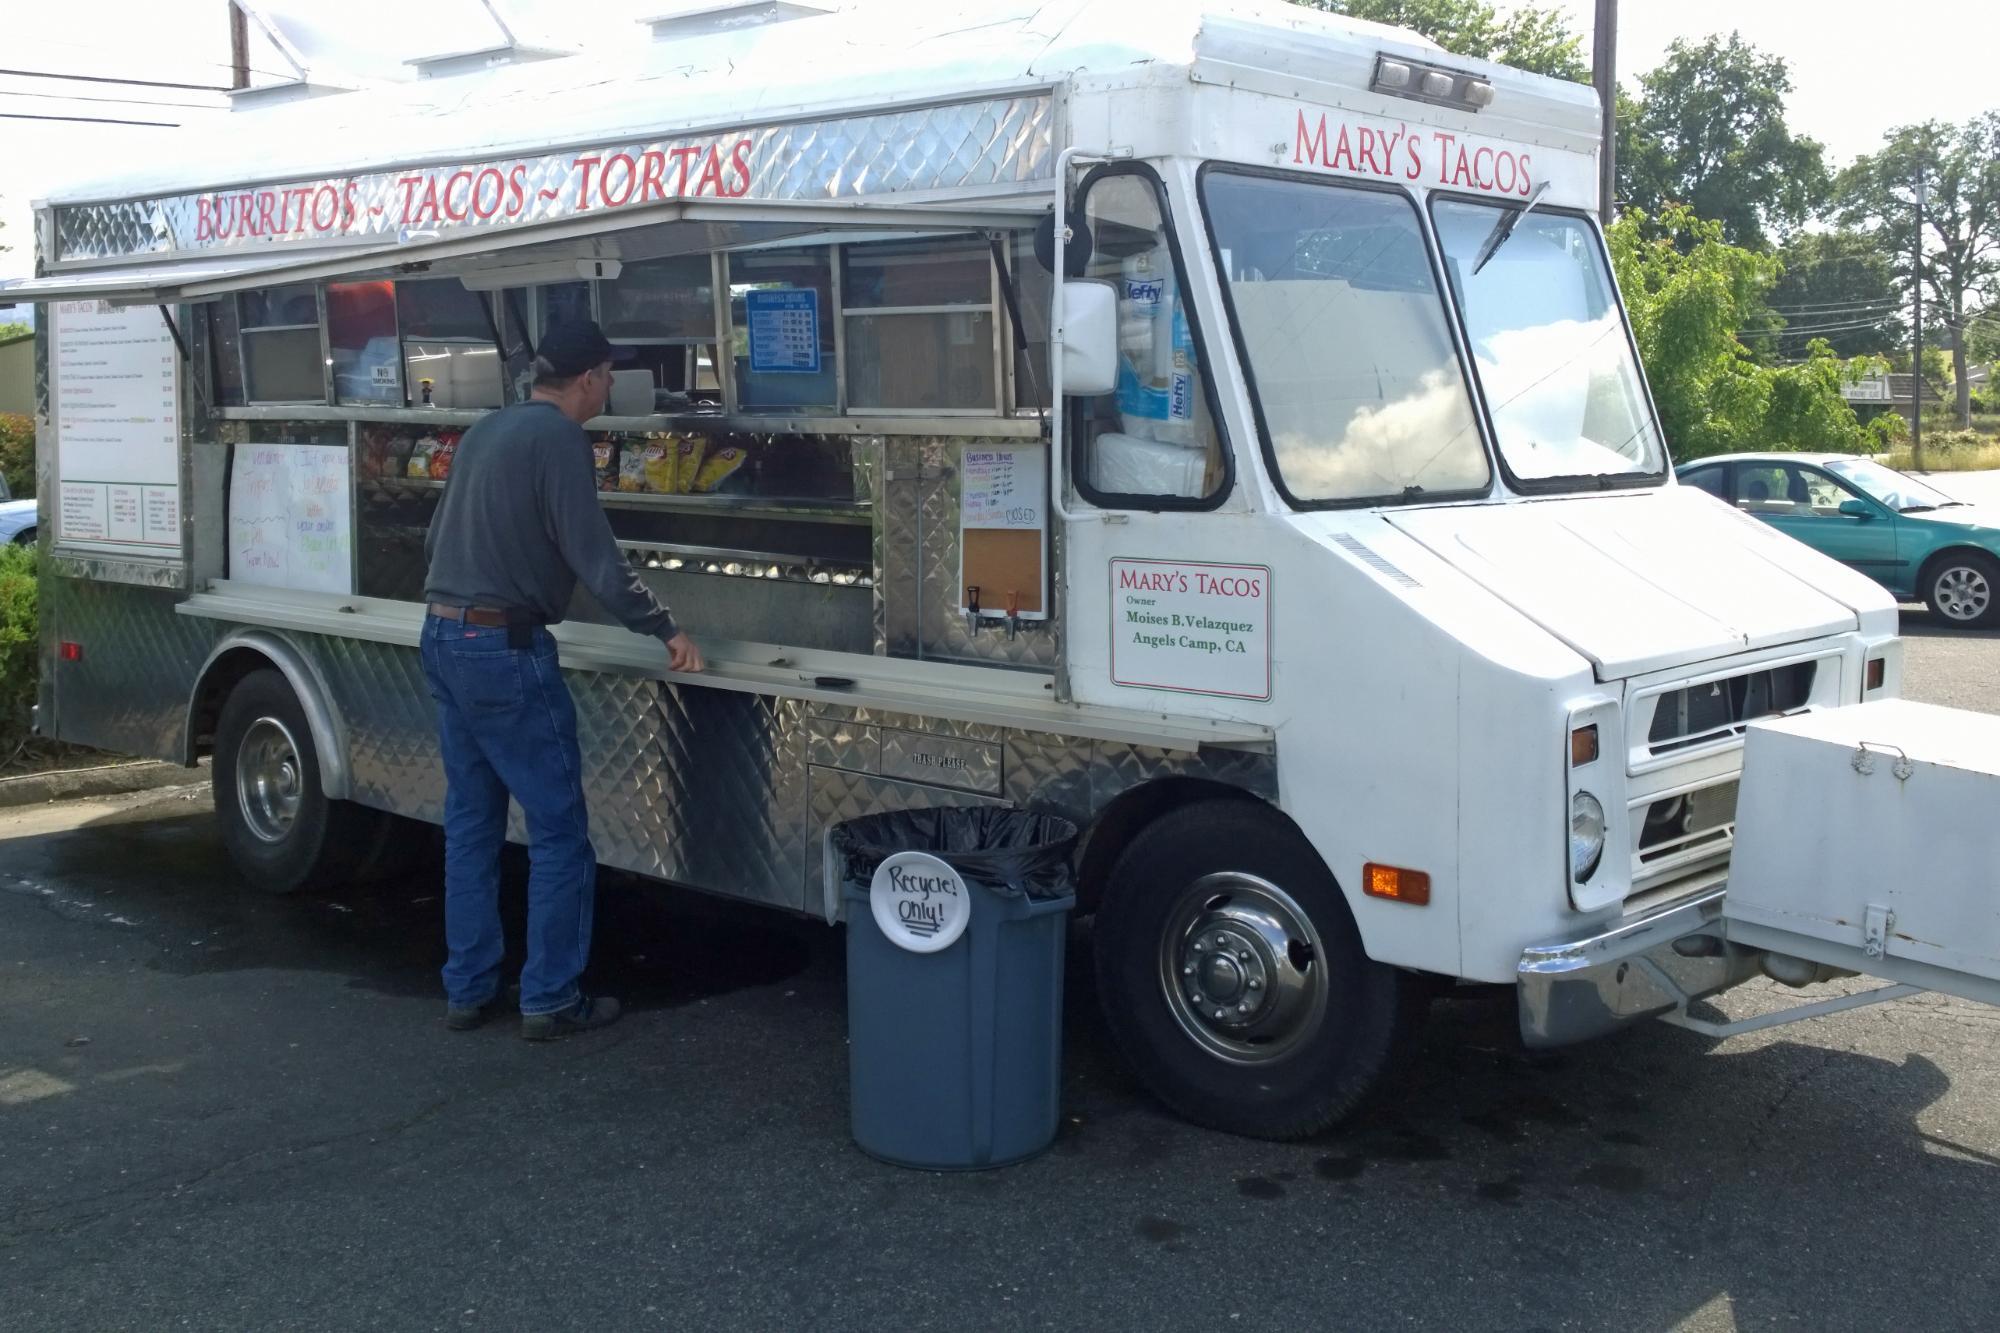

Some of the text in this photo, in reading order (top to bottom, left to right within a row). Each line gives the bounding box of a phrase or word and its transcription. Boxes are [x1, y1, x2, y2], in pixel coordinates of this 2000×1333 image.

[1293, 108, 1531, 196] MARY'S TACOS
[196, 183, 357, 241] BURRITOS
[398, 165, 526, 224] TACOS
[572, 139, 752, 211] TORTAS
[1173, 375, 1186, 416] Hefty
[1119, 568, 1261, 598] MARY'S TACOS
[1126, 595, 1156, 606] Owner
[1126, 610, 1169, 625] Moises
[1132, 632, 1246, 654] Angels Camp, CA
[913, 753, 967, 770] TRASH PLEASE
[899, 899, 944, 923] Only!
